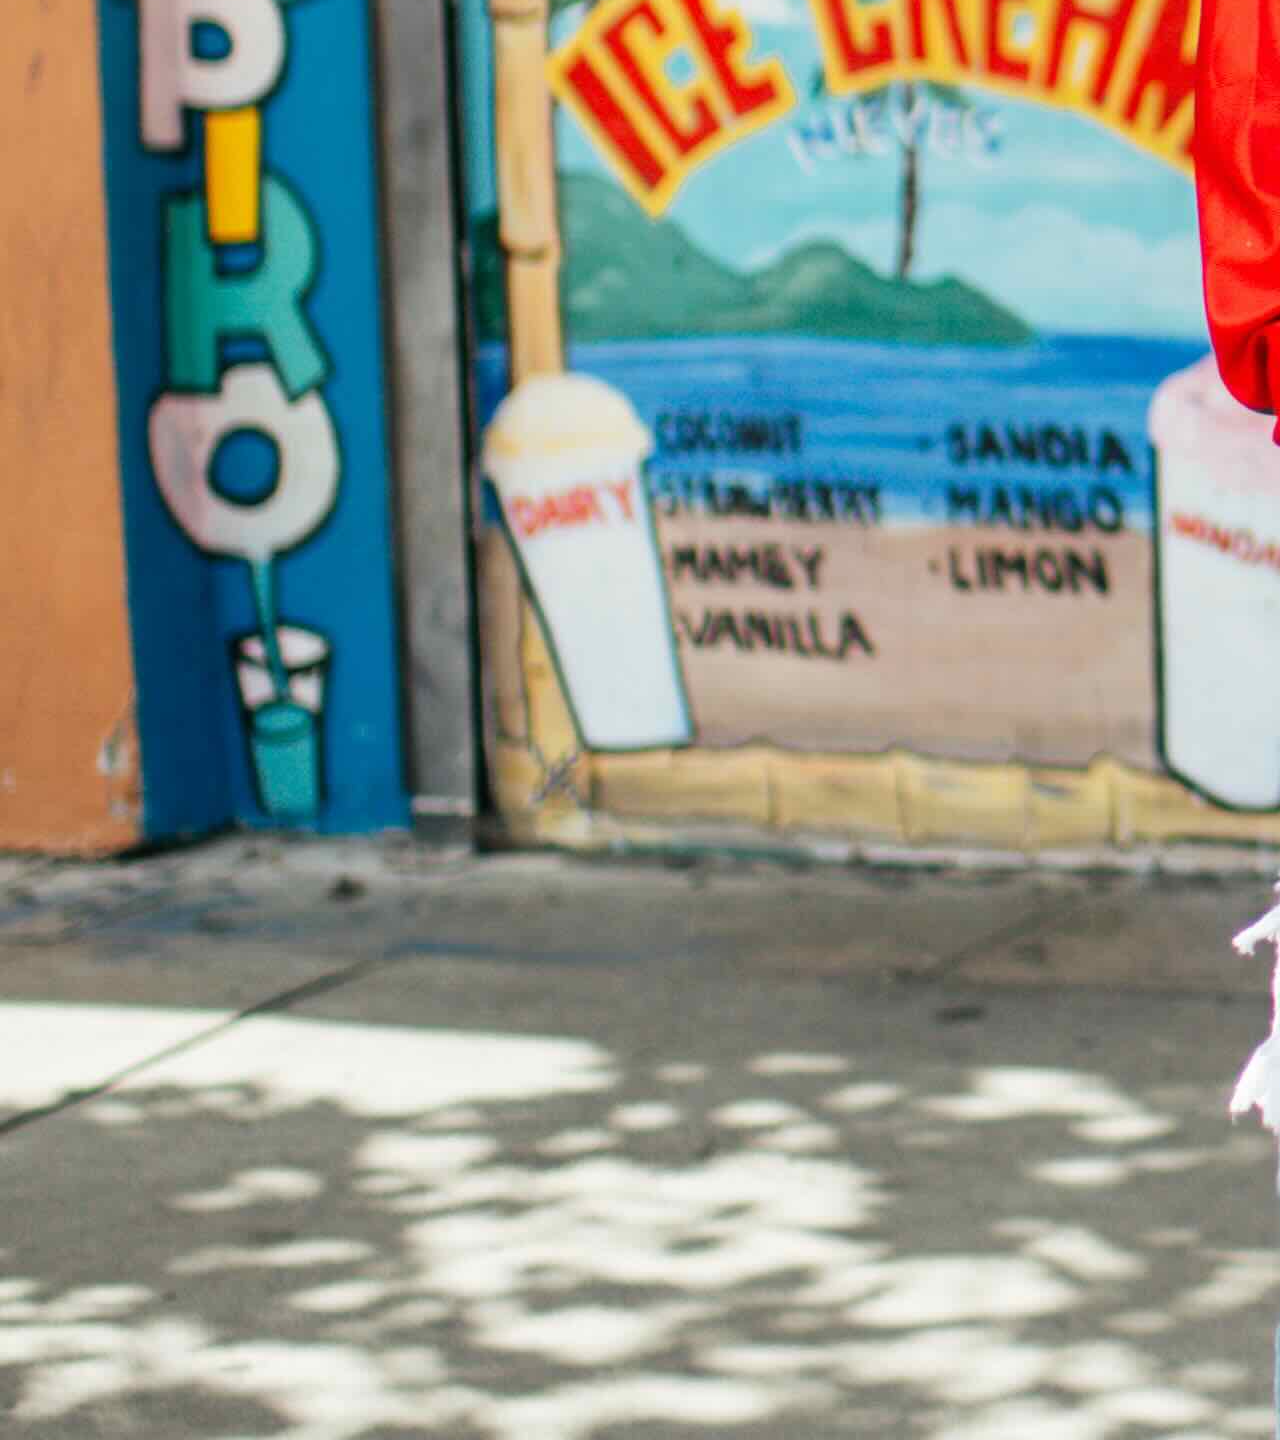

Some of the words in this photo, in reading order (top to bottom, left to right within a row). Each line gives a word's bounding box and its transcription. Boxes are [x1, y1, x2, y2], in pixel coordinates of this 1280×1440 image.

[947, 419, 1134, 473] SANDIA
[946, 479, 1125, 533] MANGO
[672, 541, 824, 589] MAMEY
[948, 543, 1111, 596] LIMON
[678, 610, 875, 660] VANILLA
